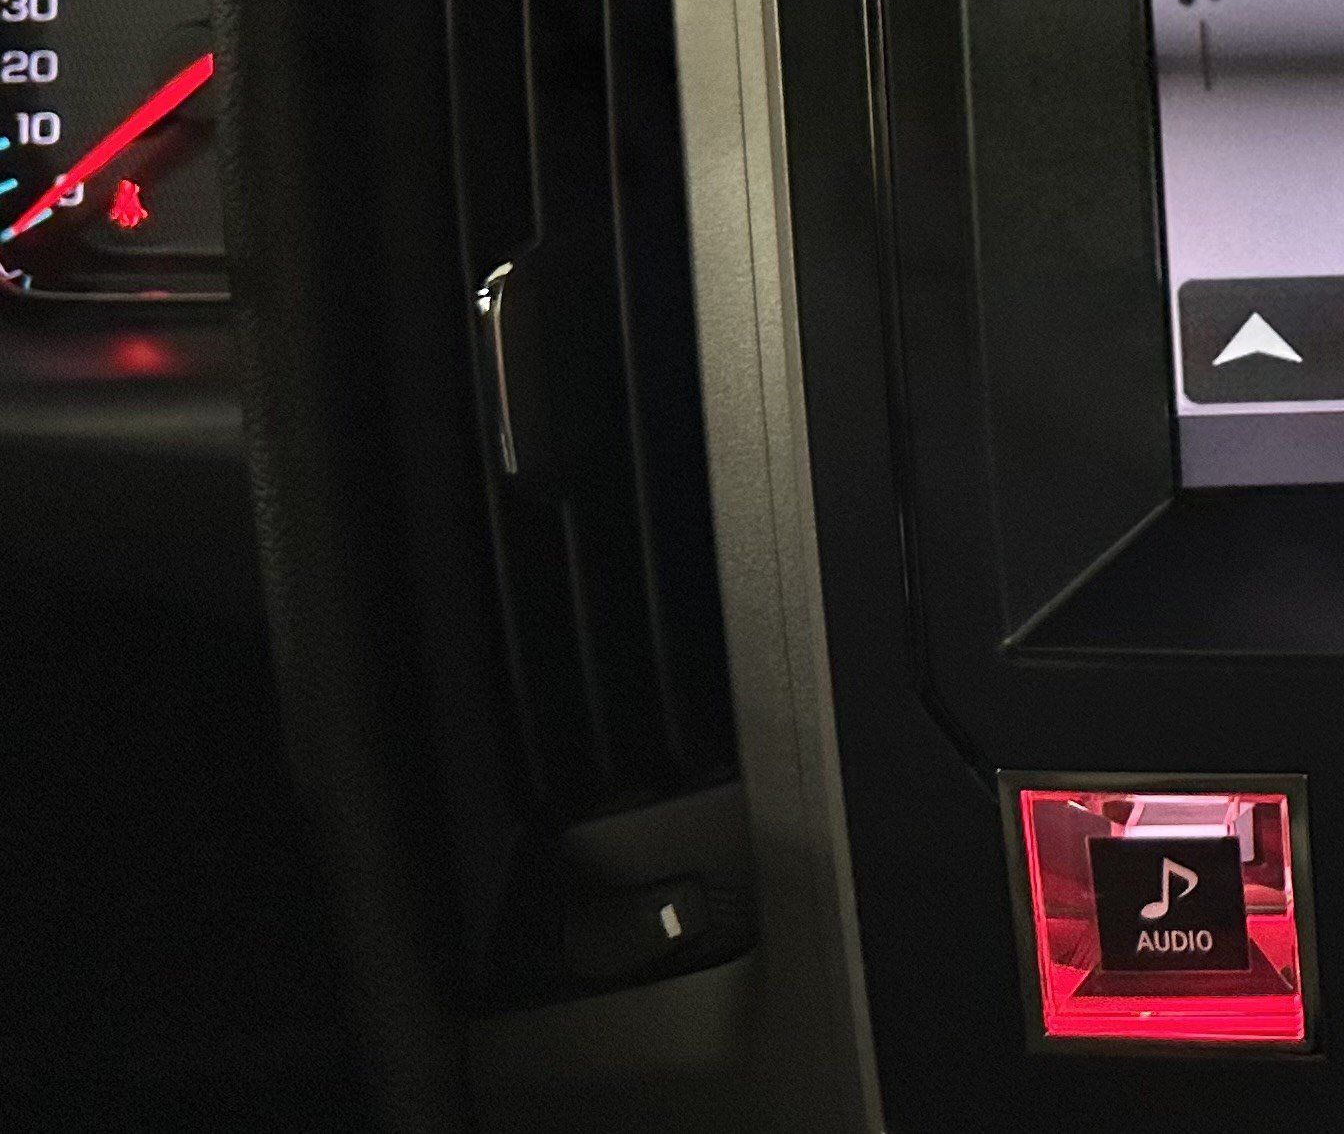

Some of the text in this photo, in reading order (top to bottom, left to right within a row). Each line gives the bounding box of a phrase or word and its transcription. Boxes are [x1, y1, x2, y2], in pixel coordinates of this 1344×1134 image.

[0, 48, 59, 84] 20
[16, 111, 61, 146] 10
[1136, 929, 1214, 953] AUDIO
